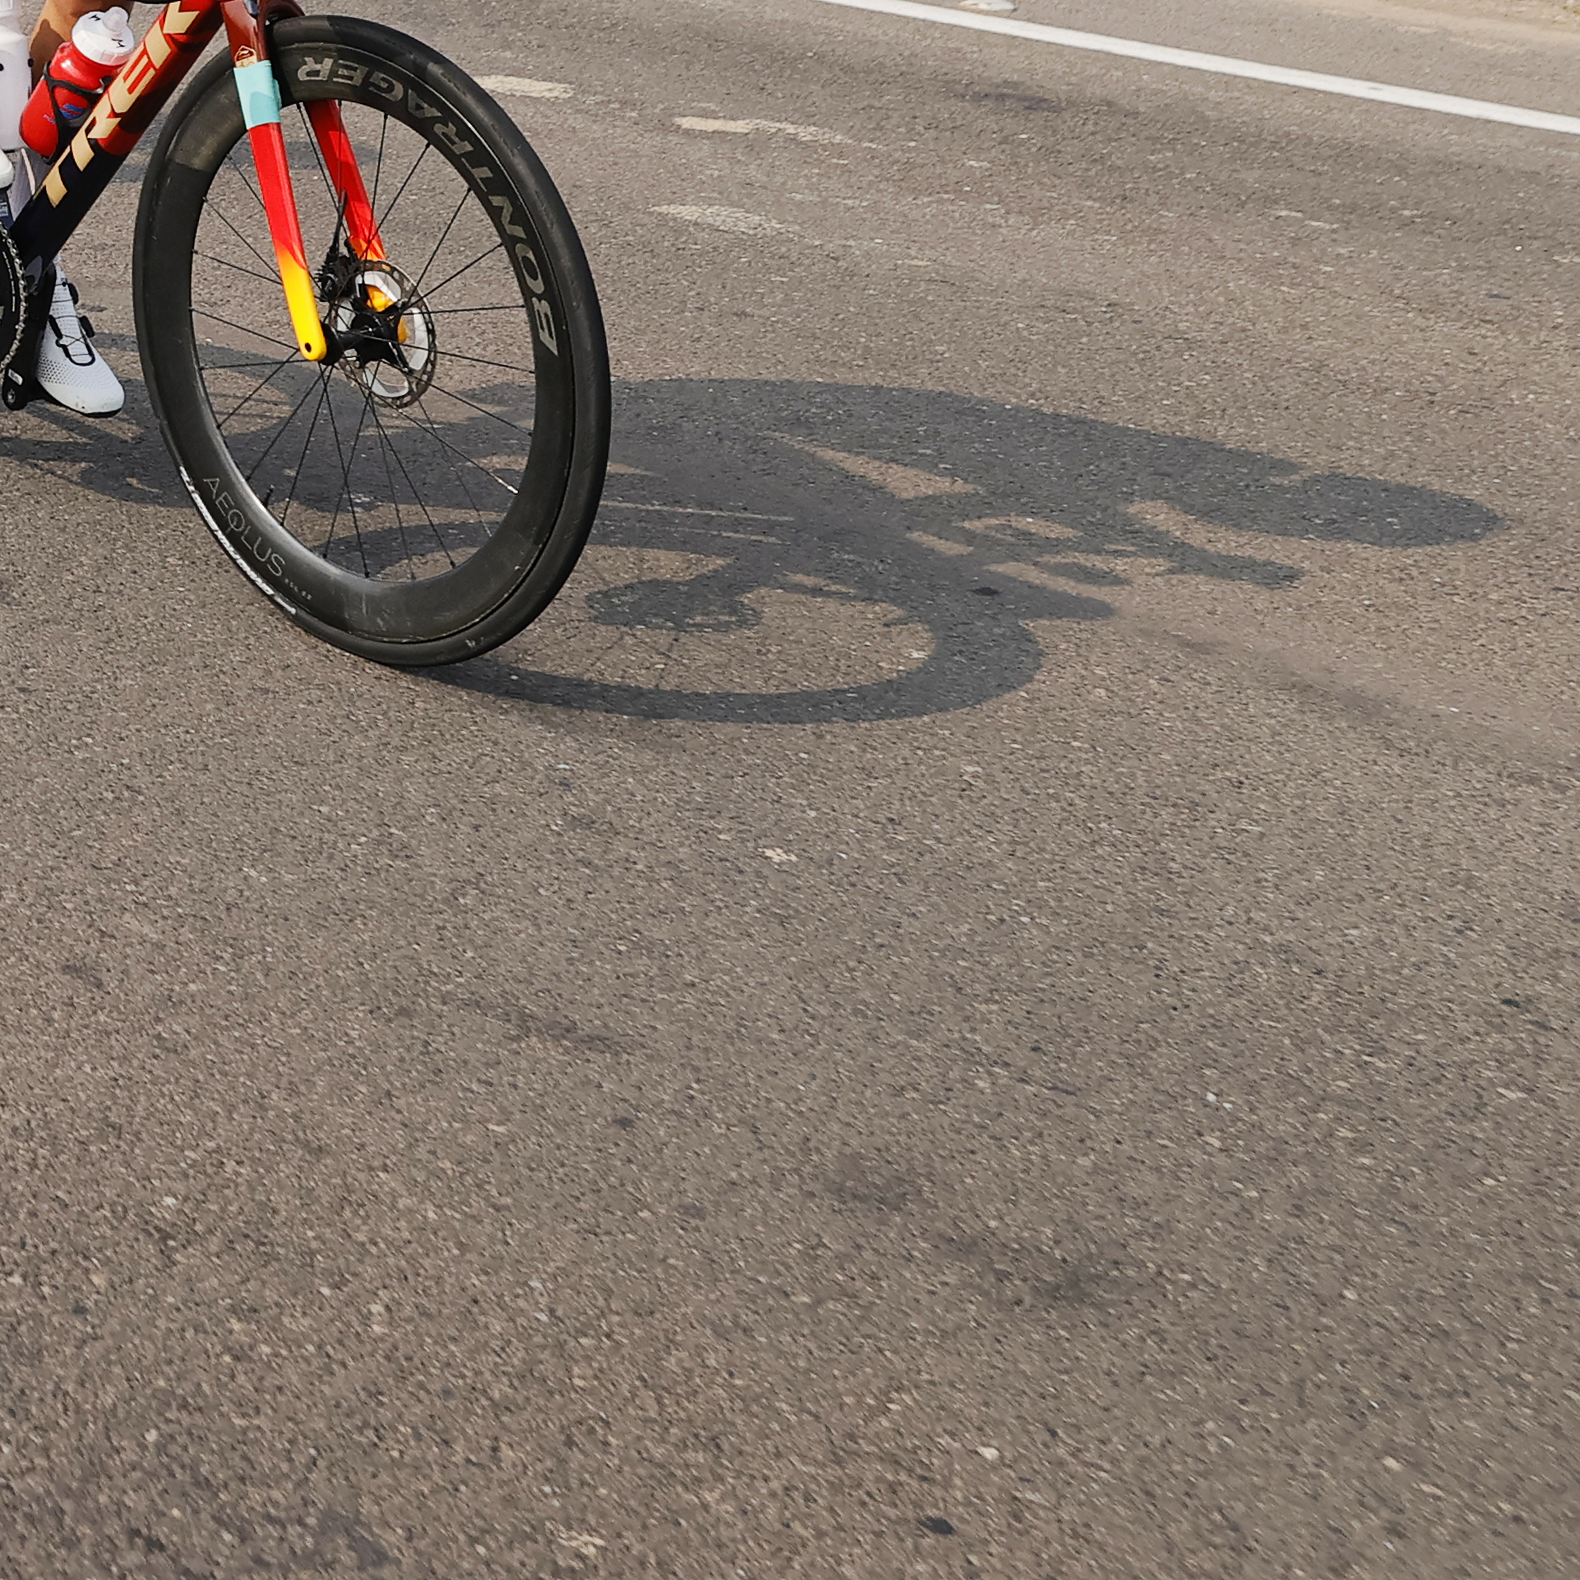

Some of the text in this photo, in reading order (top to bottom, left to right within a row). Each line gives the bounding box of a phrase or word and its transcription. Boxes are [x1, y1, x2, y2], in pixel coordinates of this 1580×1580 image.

[44, 0, 200, 208] TREK
[297, 56, 560, 358] BONTRAGER
[202, 476, 287, 577] AEOLUS
